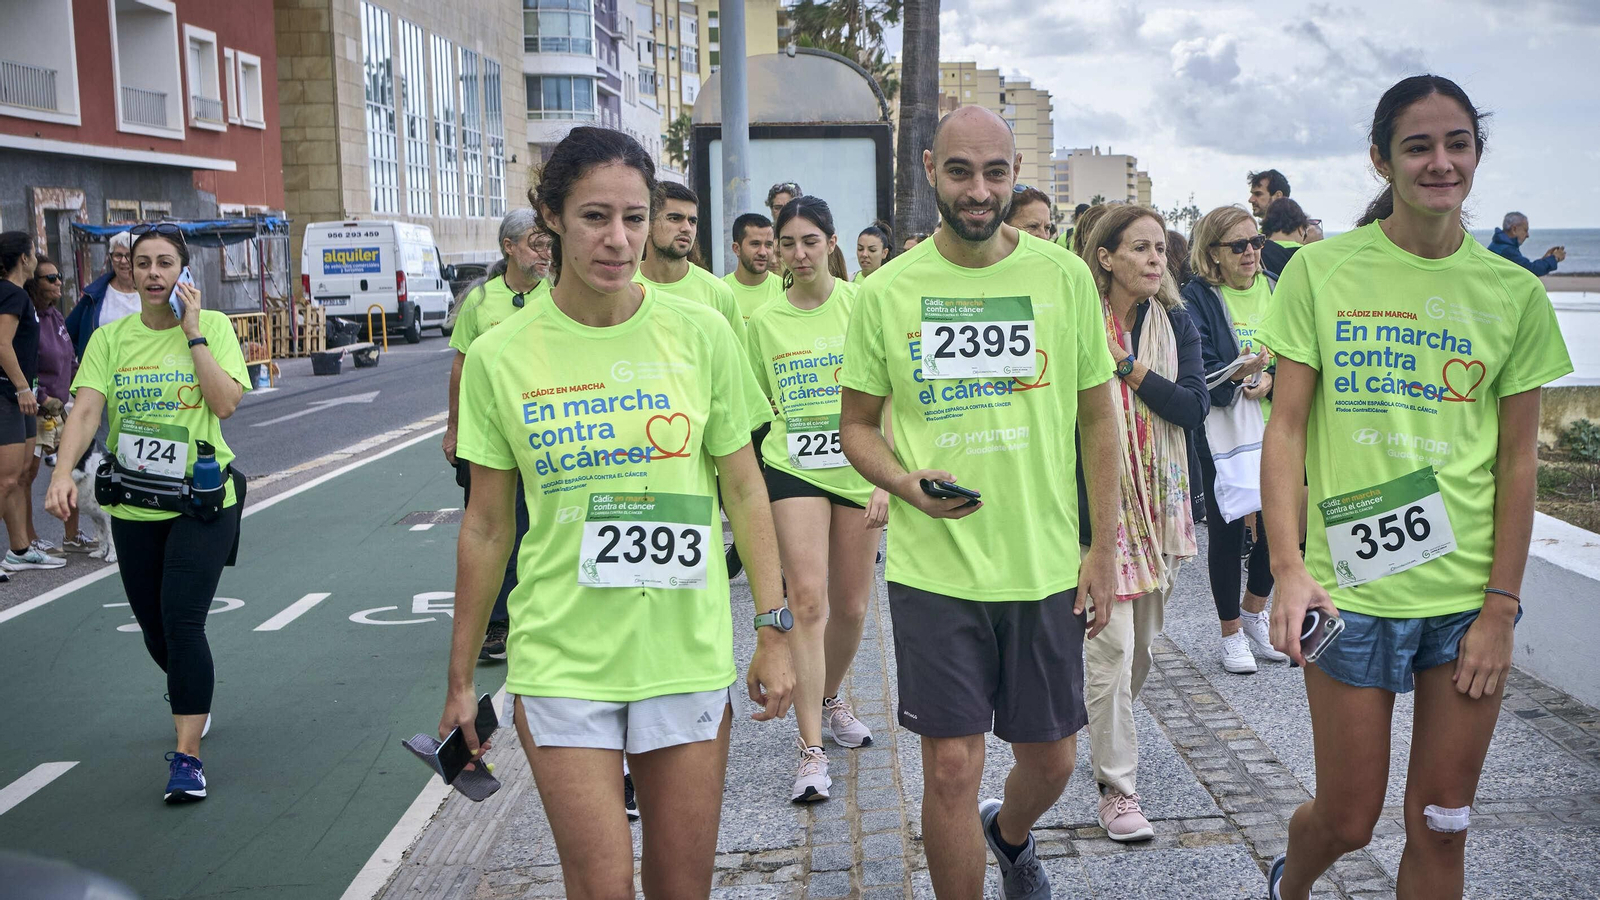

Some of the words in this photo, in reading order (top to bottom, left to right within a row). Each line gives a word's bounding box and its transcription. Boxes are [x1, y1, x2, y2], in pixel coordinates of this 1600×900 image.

[324, 248, 378, 265] alquiler
[1346, 309, 1371, 317] CÁDIZ
[1385, 310, 1418, 320] MARCHA
[935, 325, 1030, 358] 2395
[1336, 320, 1367, 342] En
[1376, 325, 1472, 356] marcha
[909, 341, 922, 361] E
[1334, 347, 1416, 371] contra
[774, 362, 786, 375] En
[790, 353, 844, 370] marcha
[114, 374, 130, 386] En
[134, 370, 194, 384] marcha
[1334, 371, 1359, 393] el
[1366, 372, 1448, 402] cáncer
[116, 386, 162, 400] contra
[531, 388, 555, 398] CÁDIZ
[569, 382, 605, 392] MARCHA
[789, 385, 842, 400] cáncer
[919, 384, 937, 405] el
[942, 380, 1016, 401] cáncer
[118, 401, 132, 414] el
[523, 402, 556, 424] En
[563, 389, 670, 418] marcha
[1417, 406, 1438, 414] CÁNCER
[529, 421, 615, 450] contra
[965, 426, 1029, 444] HYUNDAI
[134, 438, 176, 464] 124
[536, 452, 559, 476] el
[560, 444, 656, 471] cáncer
[541, 480, 564, 489] ASOCIACI
[564, 475, 594, 485] ESPAÑOLA
[1322, 499, 1341, 508] Cádiz
[1351, 489, 1381, 500] marcha
[1326, 505, 1347, 515] contra
[1356, 496, 1383, 508] cáncer
[1351, 505, 1431, 560] 356
[596, 525, 702, 567] 2393
